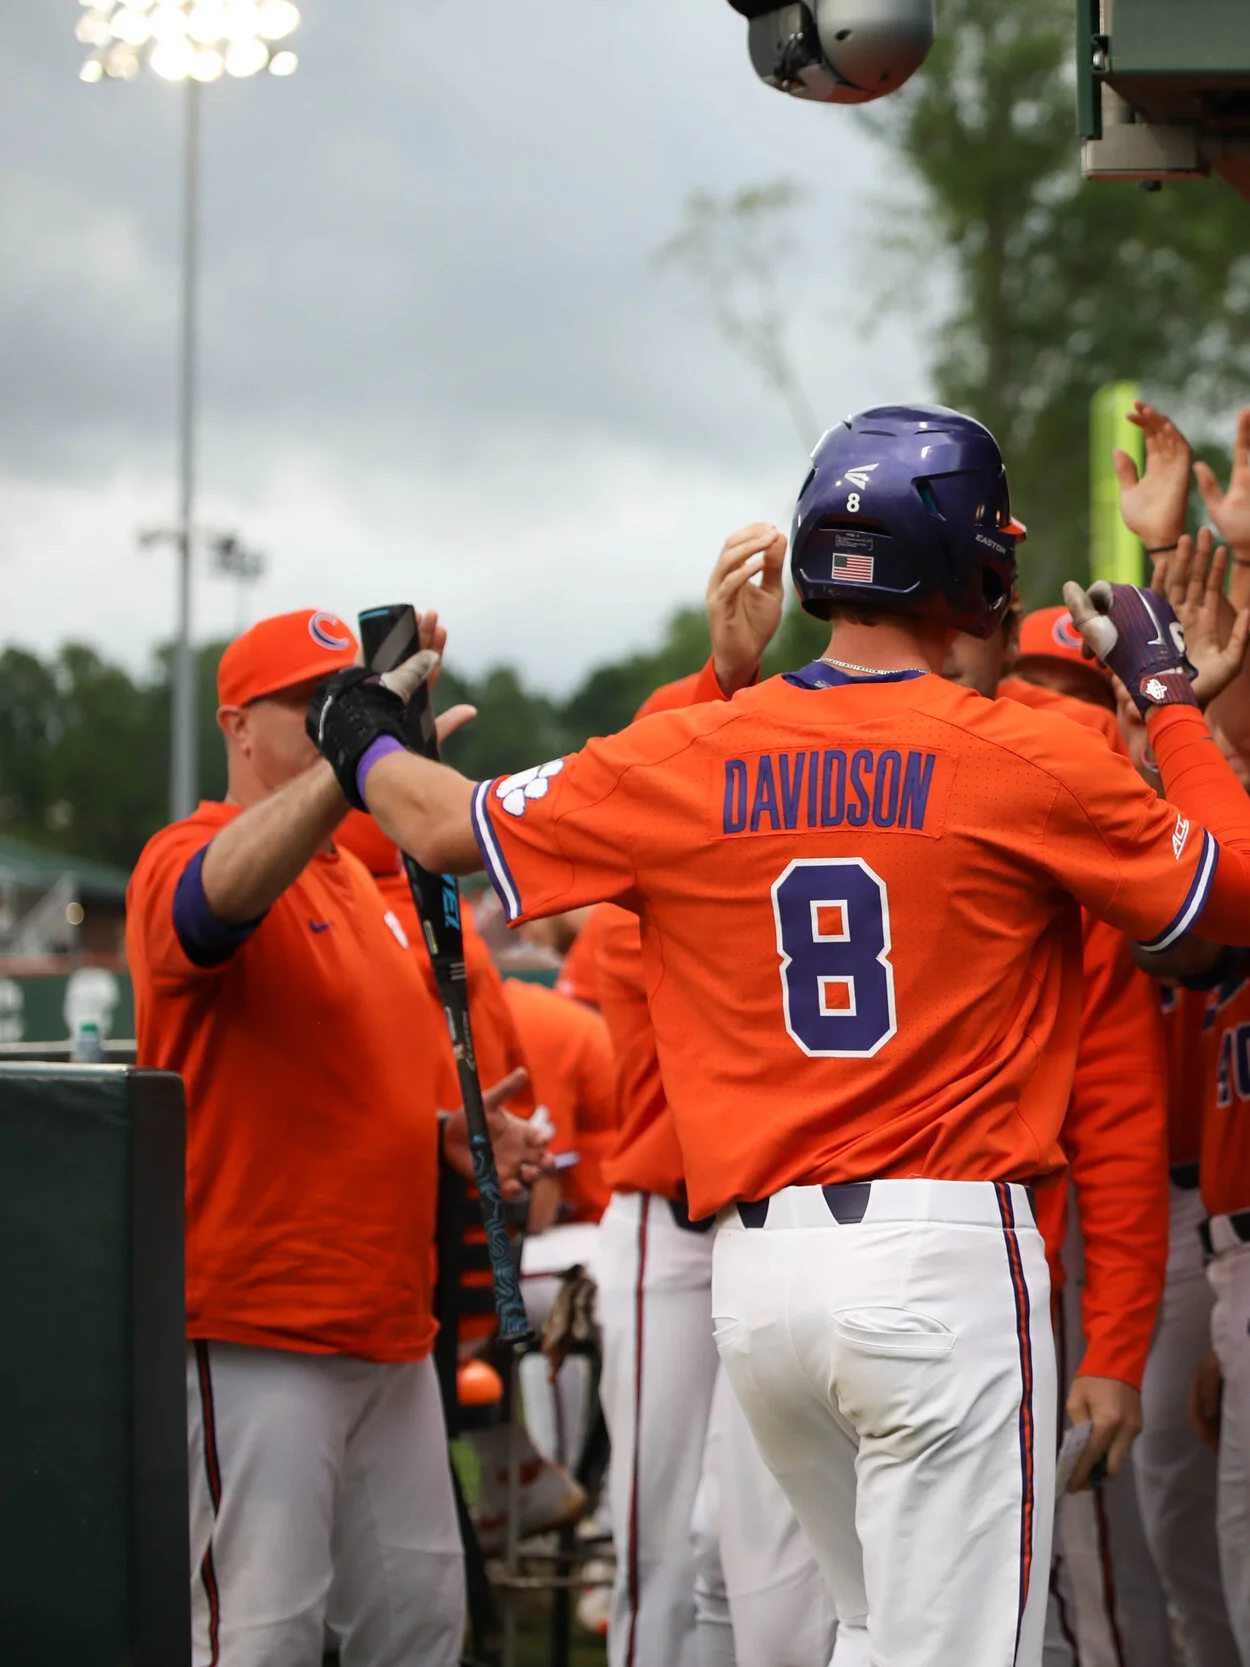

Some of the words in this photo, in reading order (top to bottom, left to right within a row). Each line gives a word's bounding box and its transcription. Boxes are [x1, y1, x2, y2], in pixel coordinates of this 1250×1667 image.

[846, 492, 860, 513] 8
[975, 533, 1006, 555] EASTON
[308, 611, 350, 651] C
[722, 749, 936, 834] DAVIDSON
[1171, 812, 1190, 861] ACC
[770, 856, 898, 1058] 8
